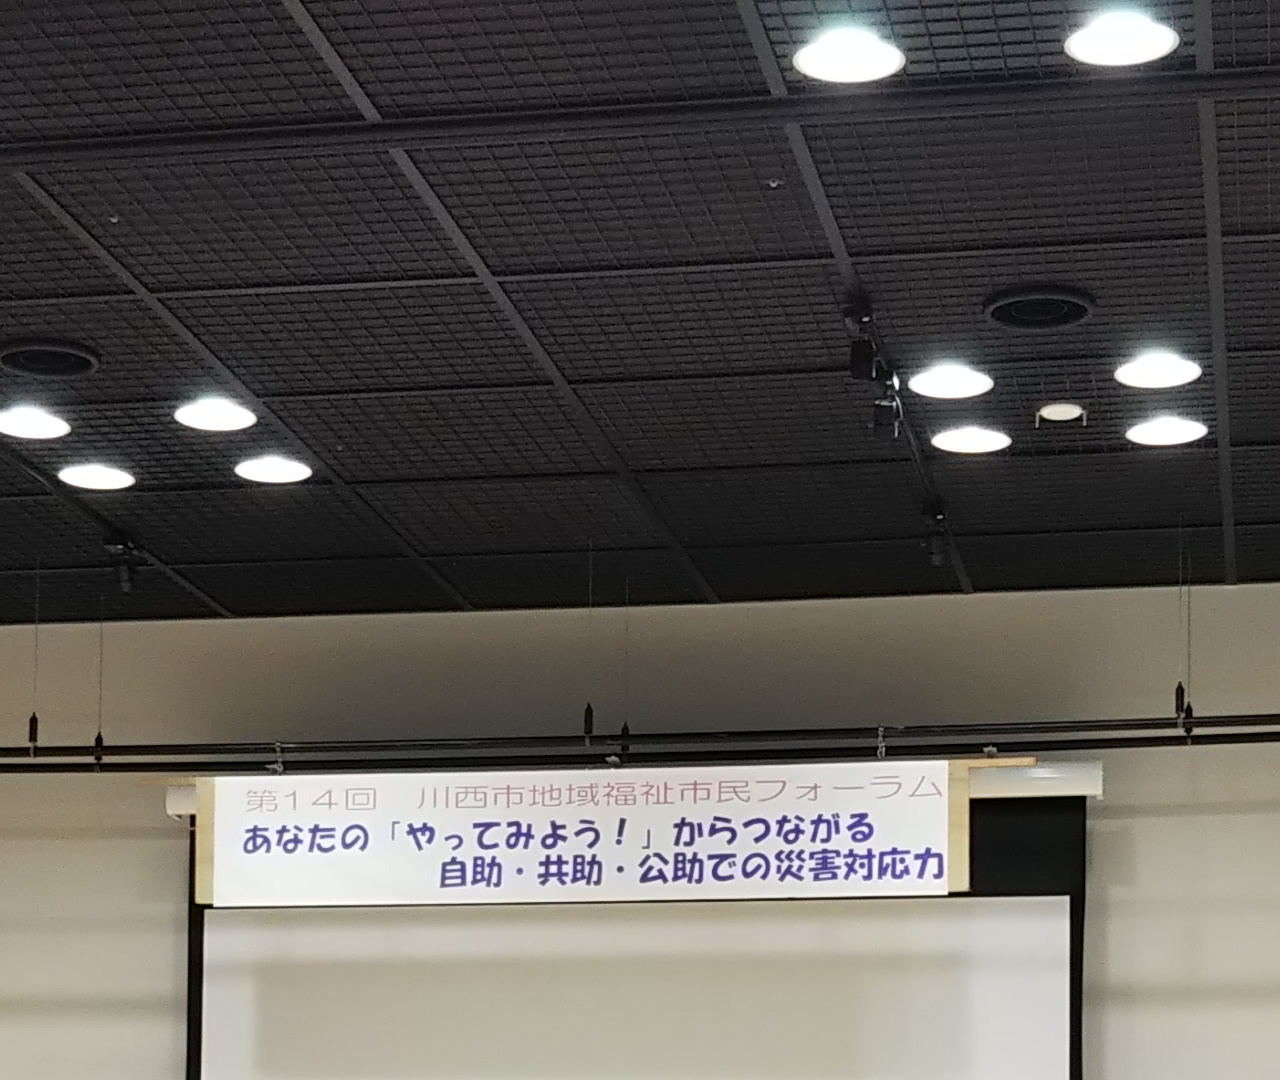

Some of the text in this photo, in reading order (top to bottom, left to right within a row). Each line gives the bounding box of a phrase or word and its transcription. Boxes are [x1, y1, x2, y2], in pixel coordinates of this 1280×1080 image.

[417, 775, 944, 810] 川西市地域福祉市民フォーラム
